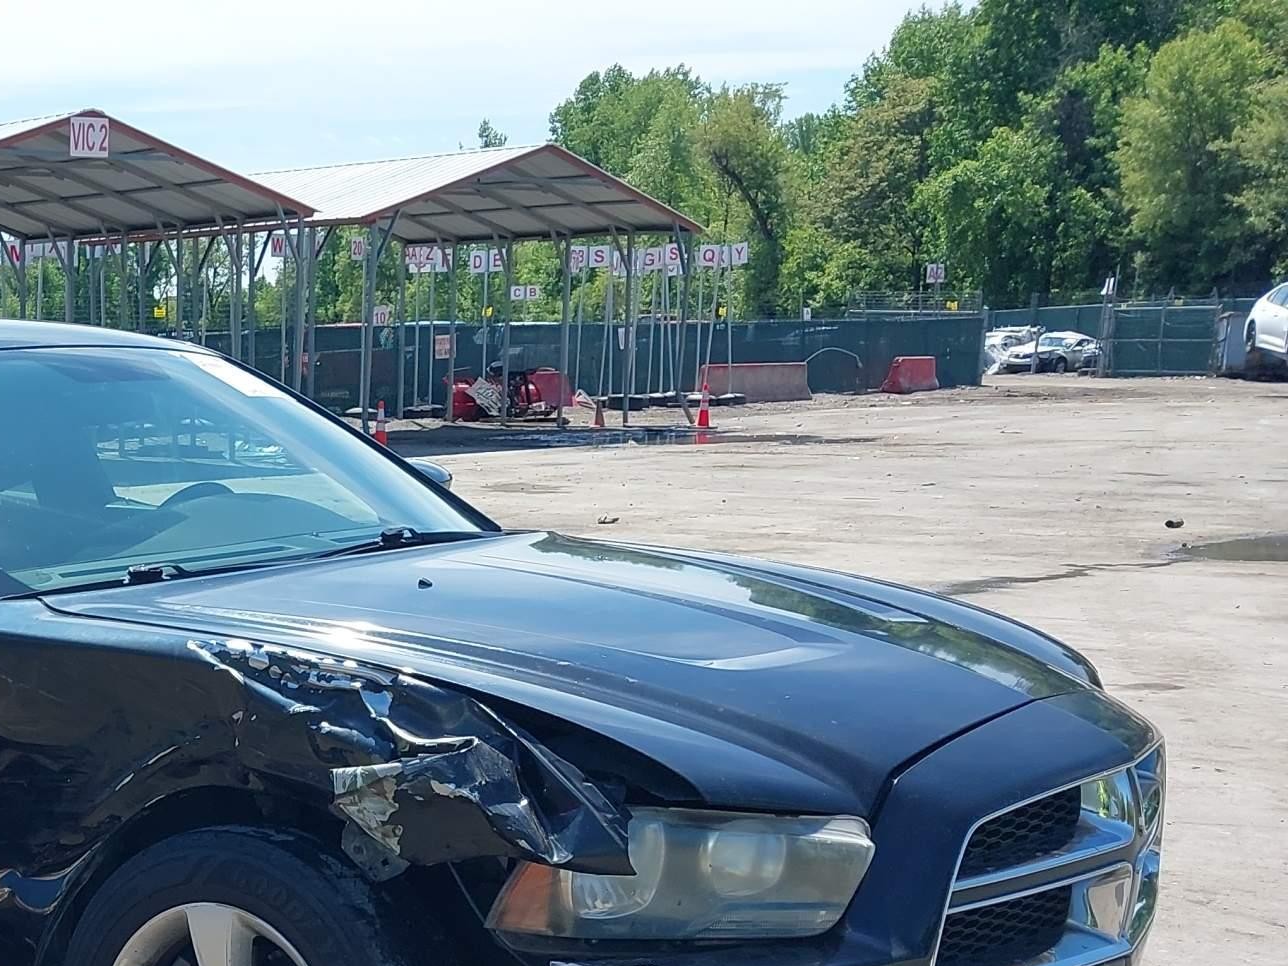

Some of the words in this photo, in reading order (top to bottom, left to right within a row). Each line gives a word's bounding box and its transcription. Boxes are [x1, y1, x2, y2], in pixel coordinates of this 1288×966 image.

[72, 122, 95, 151] VIC
[99, 124, 107, 151] 2
[271, 237, 283, 253] W
[352, 241, 362, 255] 20
[594, 249, 605, 263] S
[669, 247, 678, 261] S
[703, 248, 715, 263] Q
[735, 247, 744, 260] Y
[473, 255, 482, 269] D
[513, 288, 521, 298] C
[529, 287, 537, 297] B
[375, 312, 386, 324] 10
